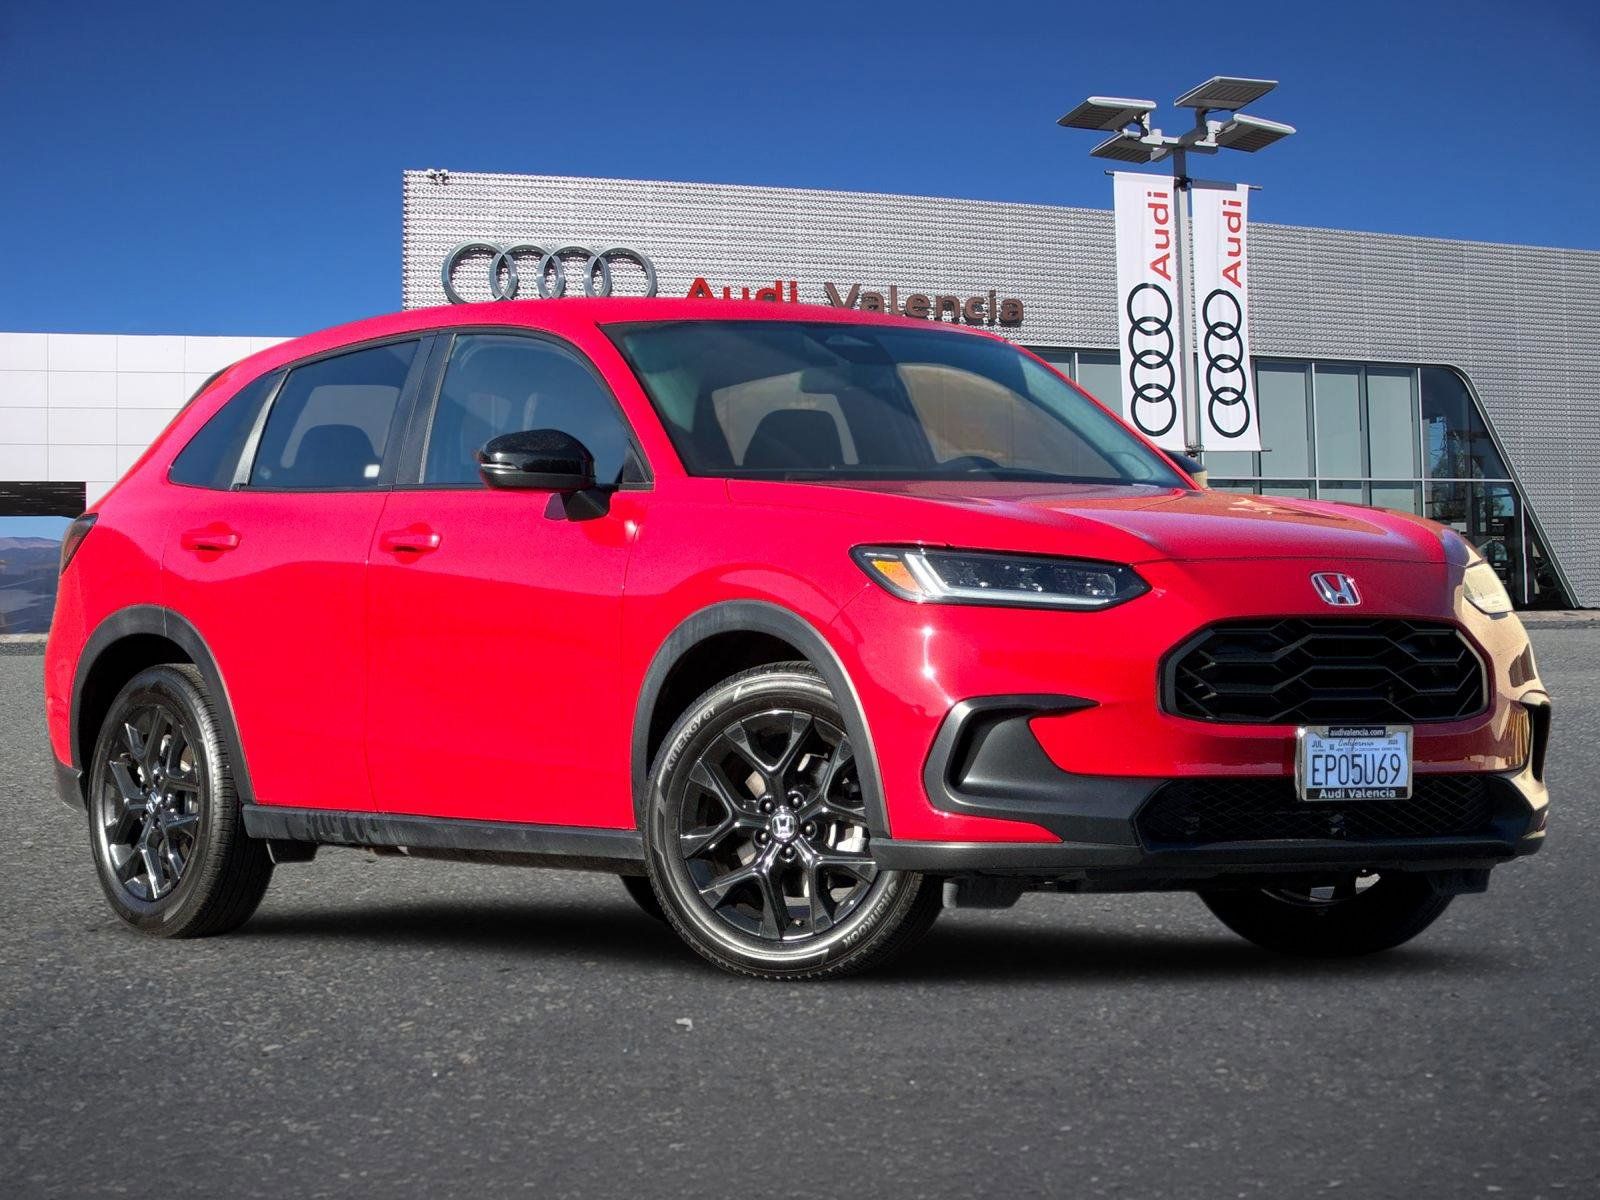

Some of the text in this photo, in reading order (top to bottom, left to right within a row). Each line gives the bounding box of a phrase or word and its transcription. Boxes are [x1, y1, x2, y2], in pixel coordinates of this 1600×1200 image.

[1147, 190, 1172, 282] Audi
[1222, 198, 1243, 289] Audi
[824, 281, 1024, 322] Valencia
[1311, 740, 1323, 748] JUL
[1337, 738, 1375, 751] California
[1329, 728, 1384, 737] audivalencia.com
[1311, 753, 1401, 786] EP05U69
[1319, 788, 1396, 799] Audi Valencia
